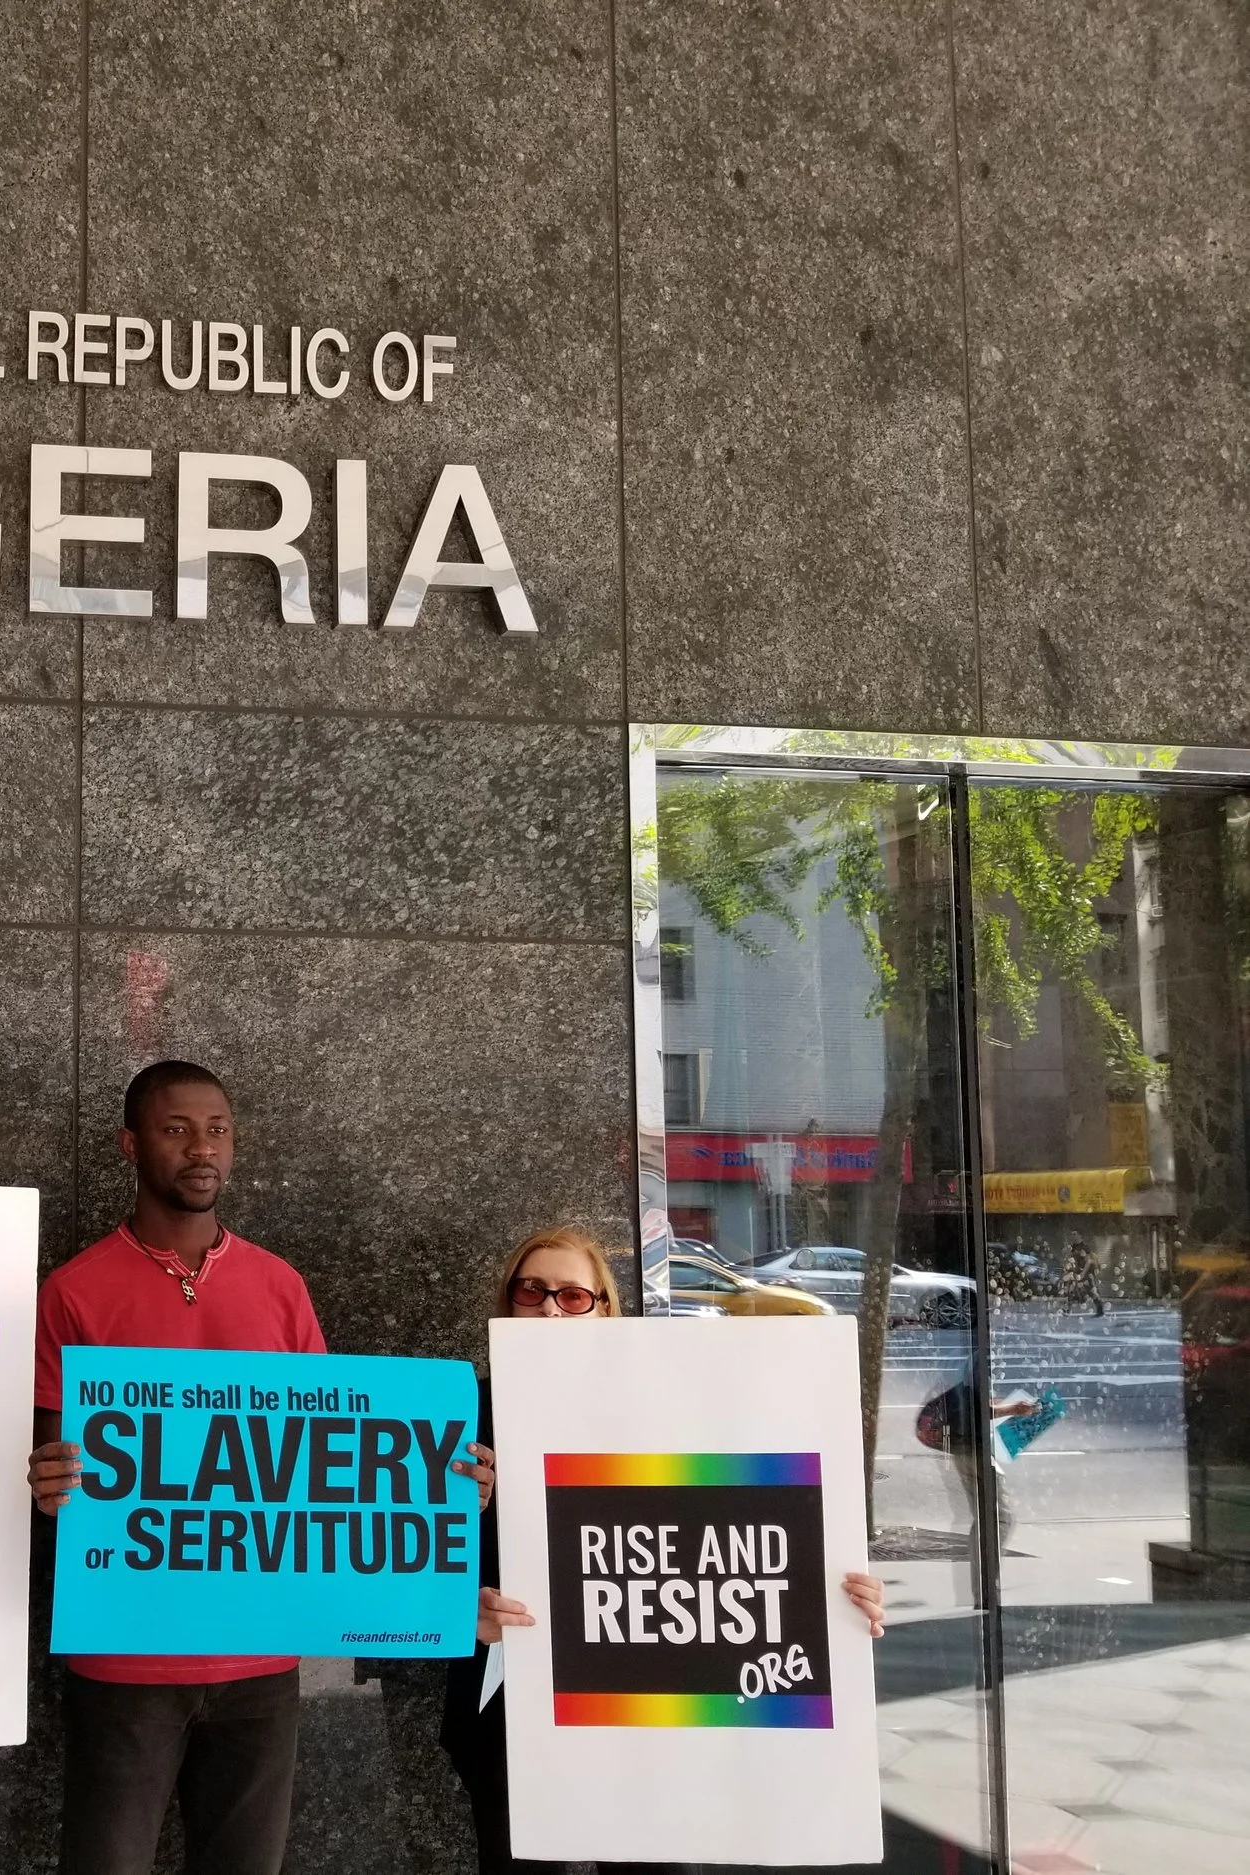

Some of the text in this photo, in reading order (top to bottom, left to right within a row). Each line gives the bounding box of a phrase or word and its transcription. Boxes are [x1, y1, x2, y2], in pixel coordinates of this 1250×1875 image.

[27, 310, 350, 399] REPUBLIC
[372, 330, 456, 402] OF
[79, 1380, 370, 1413] NO ONE shall be held in
[81, 1410, 466, 1505] SLAVERY
[85, 1507, 468, 1575] or SERVITUDE
[580, 1525, 788, 1575] RISE AND
[340, 1631, 441, 1645] riseandresist.org
[582, 1579, 789, 1645] RESIST
[737, 1644, 814, 1704] .ORG
